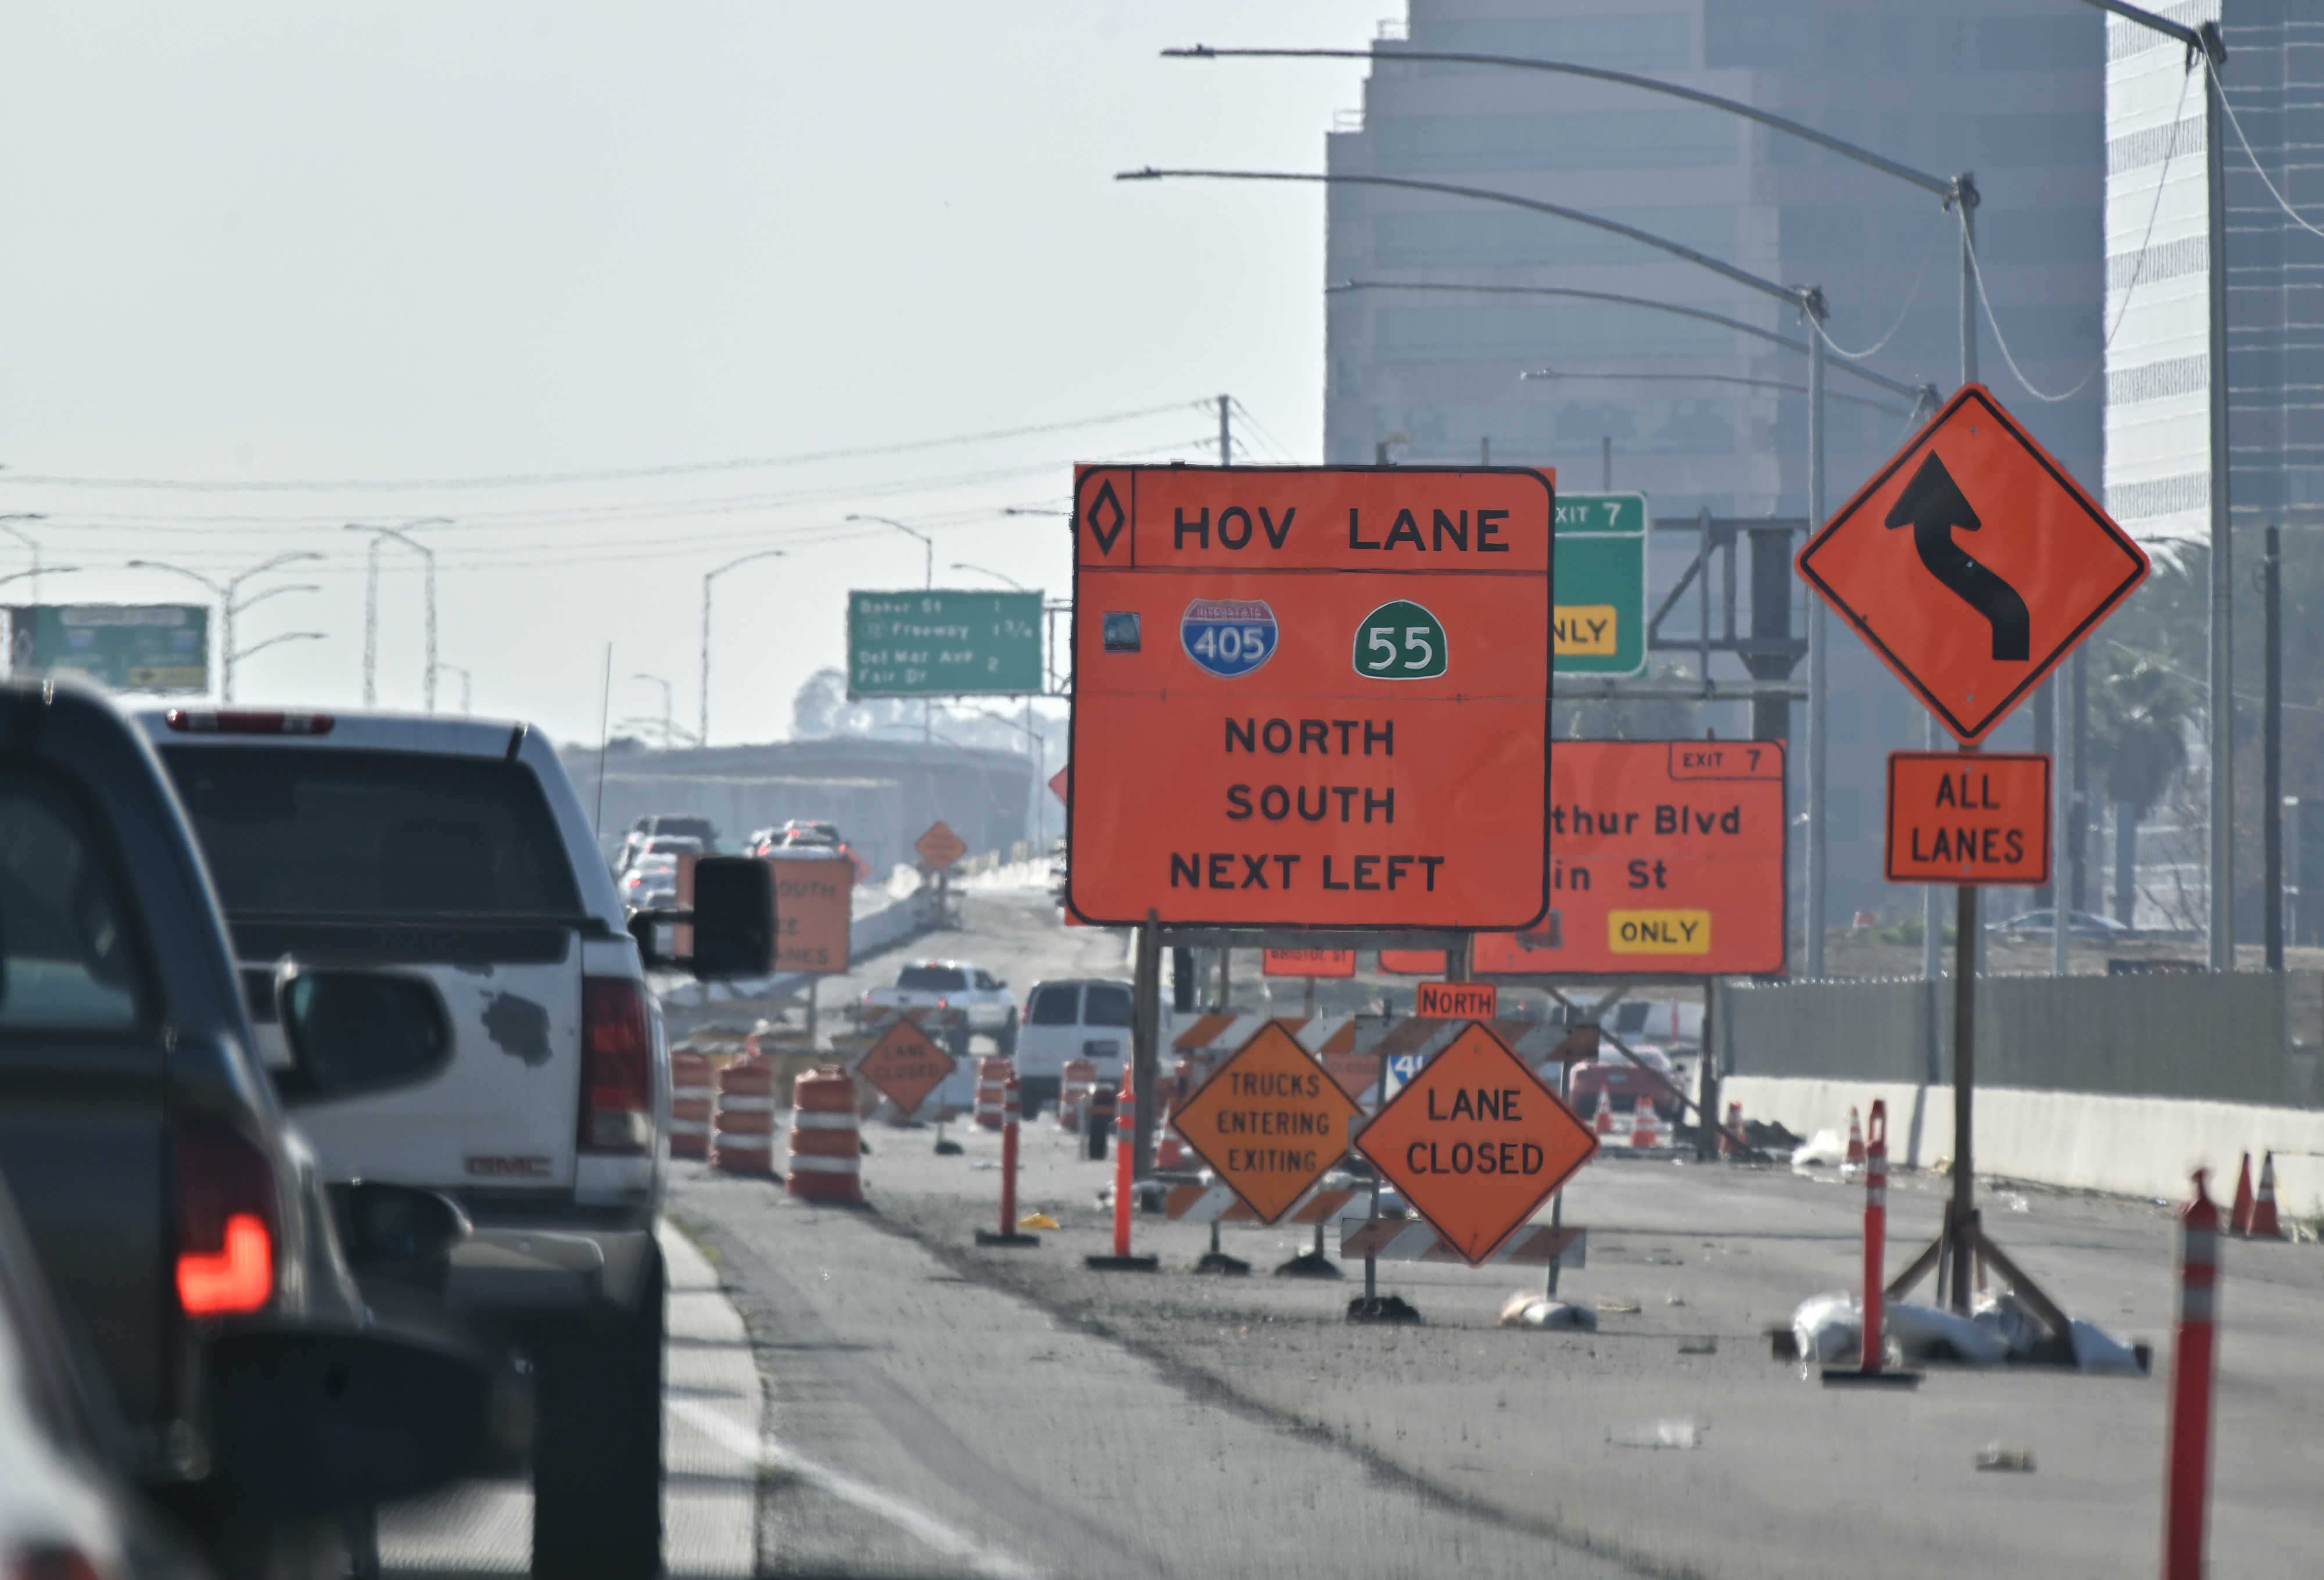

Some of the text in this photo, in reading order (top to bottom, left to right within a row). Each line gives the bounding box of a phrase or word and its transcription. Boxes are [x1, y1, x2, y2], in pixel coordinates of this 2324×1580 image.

[1555, 502, 1622, 527] XIT 7
[1174, 505, 1509, 552] HOV LANE
[921, 598, 942, 614] St
[1197, 606, 1261, 619] INTERSTATE
[892, 622, 969, 641] Freeway
[1194, 626, 1264, 662] 405
[1554, 619, 1608, 644] NLY
[858, 649, 888, 665] Del
[894, 649, 928, 664] Mar
[987, 656, 999, 672] 2
[1368, 627, 1433, 670] 55
[858, 668, 928, 685] Fair Dr
[1225, 717, 1394, 756] NORTH
[1683, 748, 1762, 773] EXIT 7
[1225, 784, 1394, 824] SOUTH
[1935, 773, 2000, 809] ALL
[1551, 804, 1741, 835] thur Blvd
[1911, 827, 2024, 864] LANES
[1171, 852, 1445, 892] NEXT LEFT
[1554, 858, 1668, 891] in St
[779, 879, 837, 899] OUTH
[1620, 920, 1699, 943] ONLY
[1422, 989, 1493, 1015] NORTH
[883, 1043, 927, 1061] LANE
[874, 1063, 939, 1081] CLOSED
[1229, 1072, 1321, 1099] TRUCKS
[1428, 1089, 1523, 1123] LANE
[1217, 1110, 1330, 1137] ENTERING
[465, 1155, 552, 1177] GMC
[1228, 1148, 1318, 1174] EXITING
[1406, 1141, 1545, 1176] CLOSED
